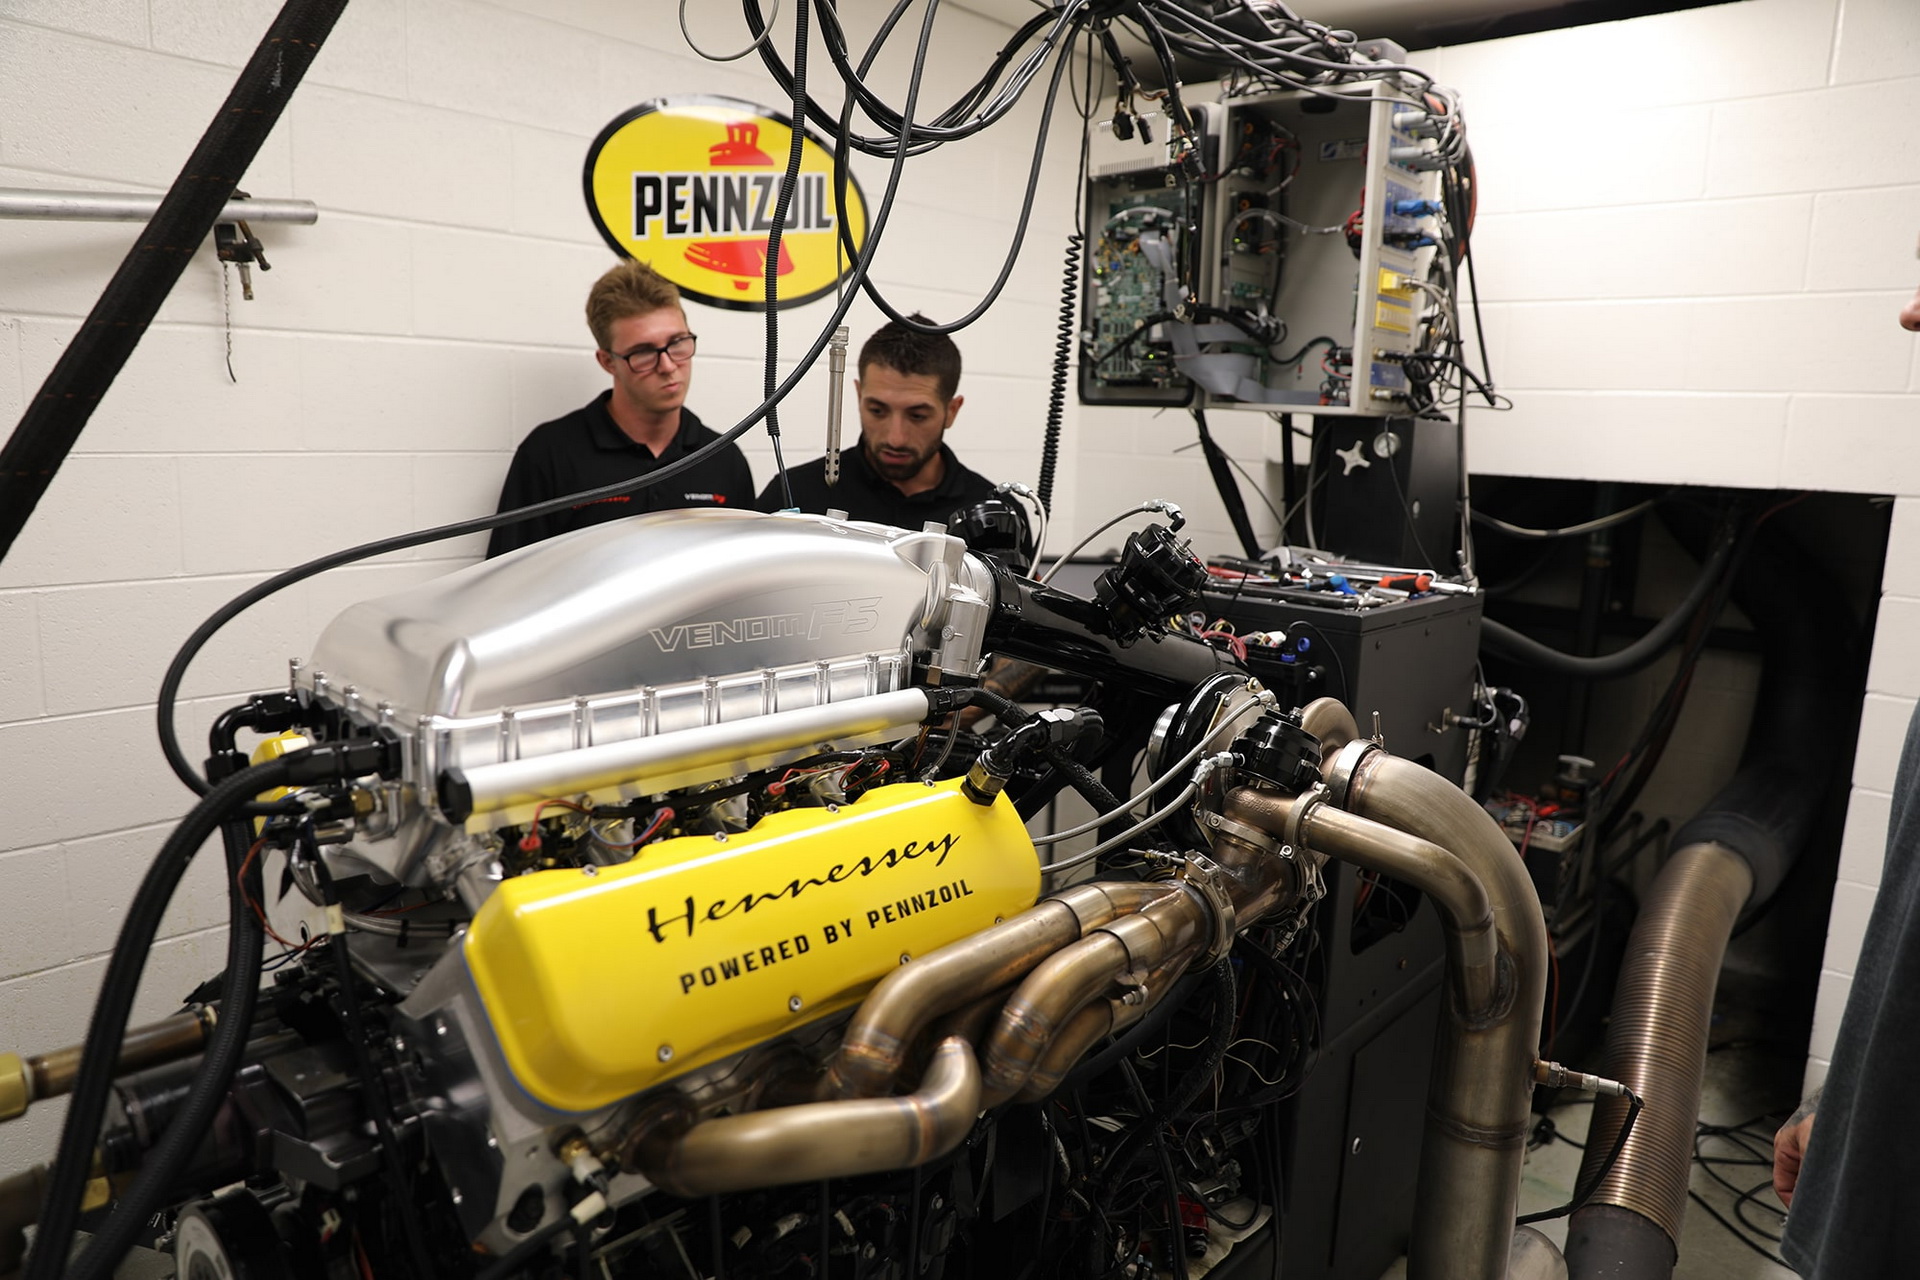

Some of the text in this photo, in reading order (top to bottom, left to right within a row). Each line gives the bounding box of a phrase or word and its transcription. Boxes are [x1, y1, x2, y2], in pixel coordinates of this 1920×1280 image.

[635, 175, 832, 236] PENNZOIL
[648, 596, 883, 652] VENOM F5
[647, 833, 960, 943] Hennessey
[680, 878, 974, 994] POWERED BY PENNZOIL
